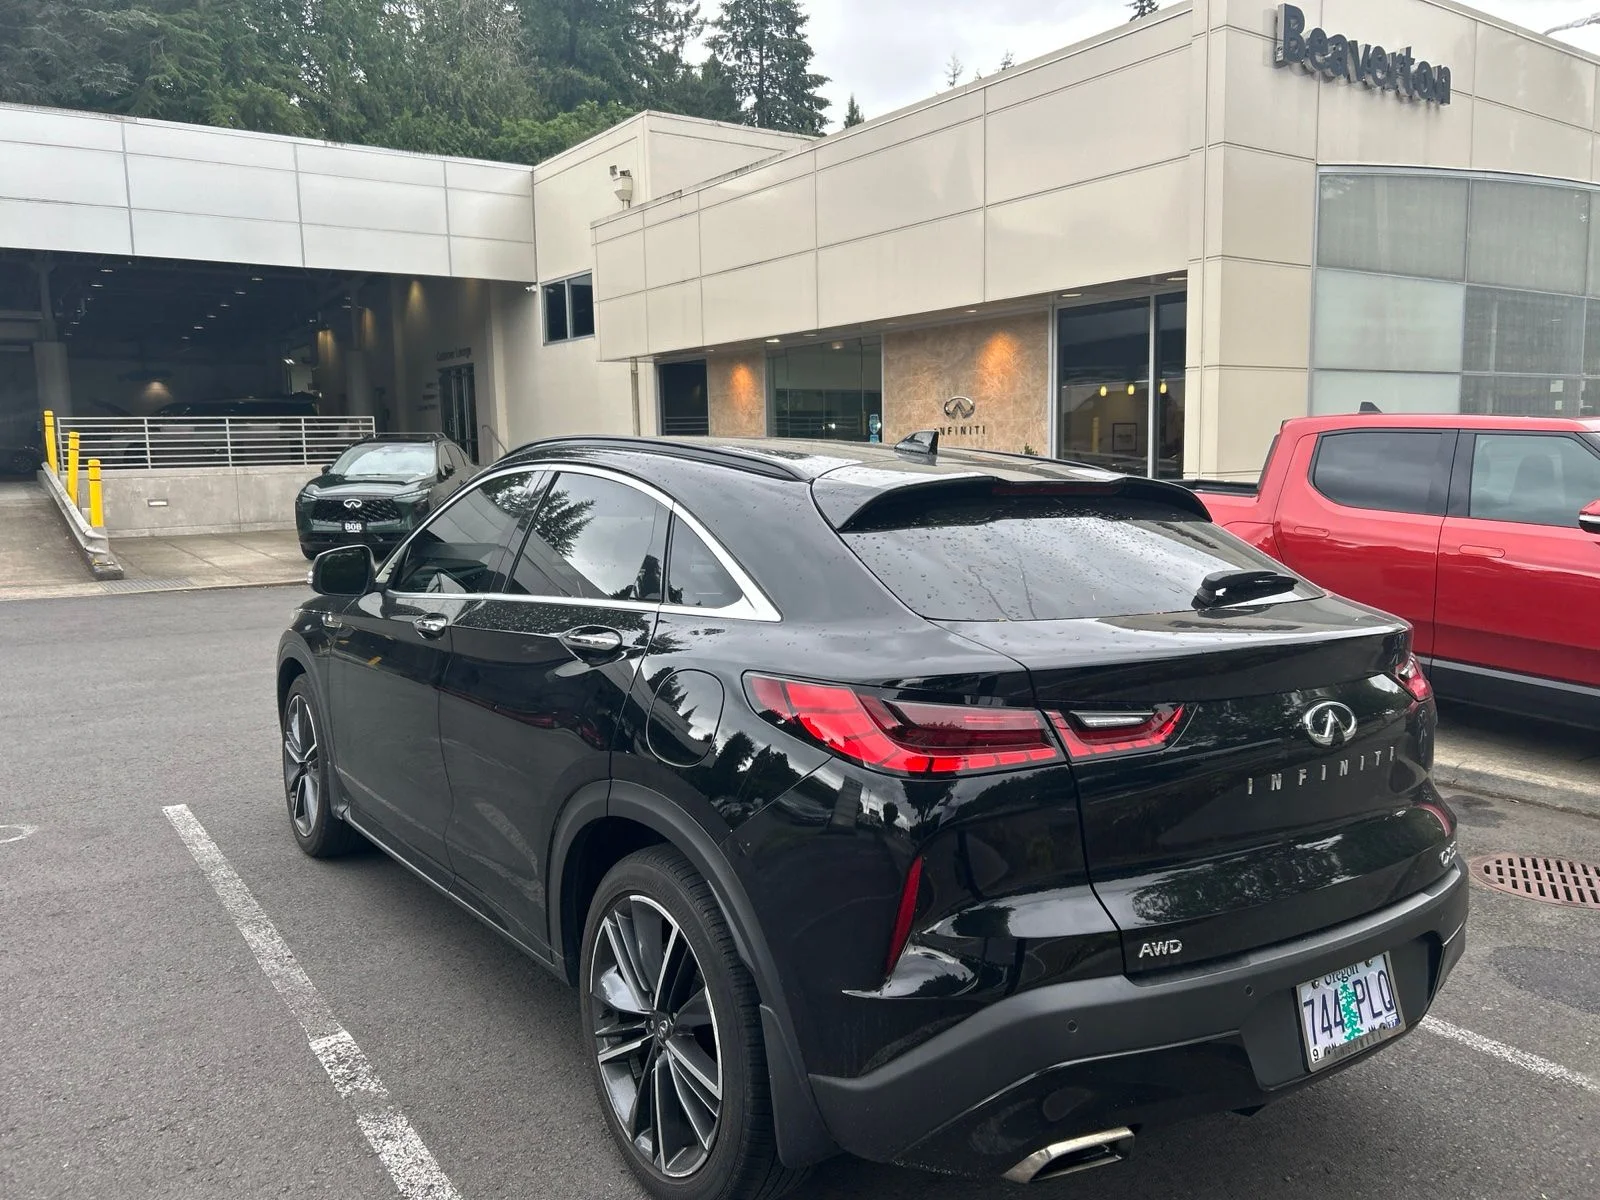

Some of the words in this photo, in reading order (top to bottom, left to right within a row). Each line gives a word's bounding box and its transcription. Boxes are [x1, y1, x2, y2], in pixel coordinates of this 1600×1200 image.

[1278, 3, 1451, 105] Beaverton
[934, 425, 985, 436] NFINITI
[1248, 746, 1395, 795] INFINITI
[1138, 939, 1183, 958] AWD
[1303, 988, 1345, 1045] 744
[1352, 969, 1395, 1025] PLQ
